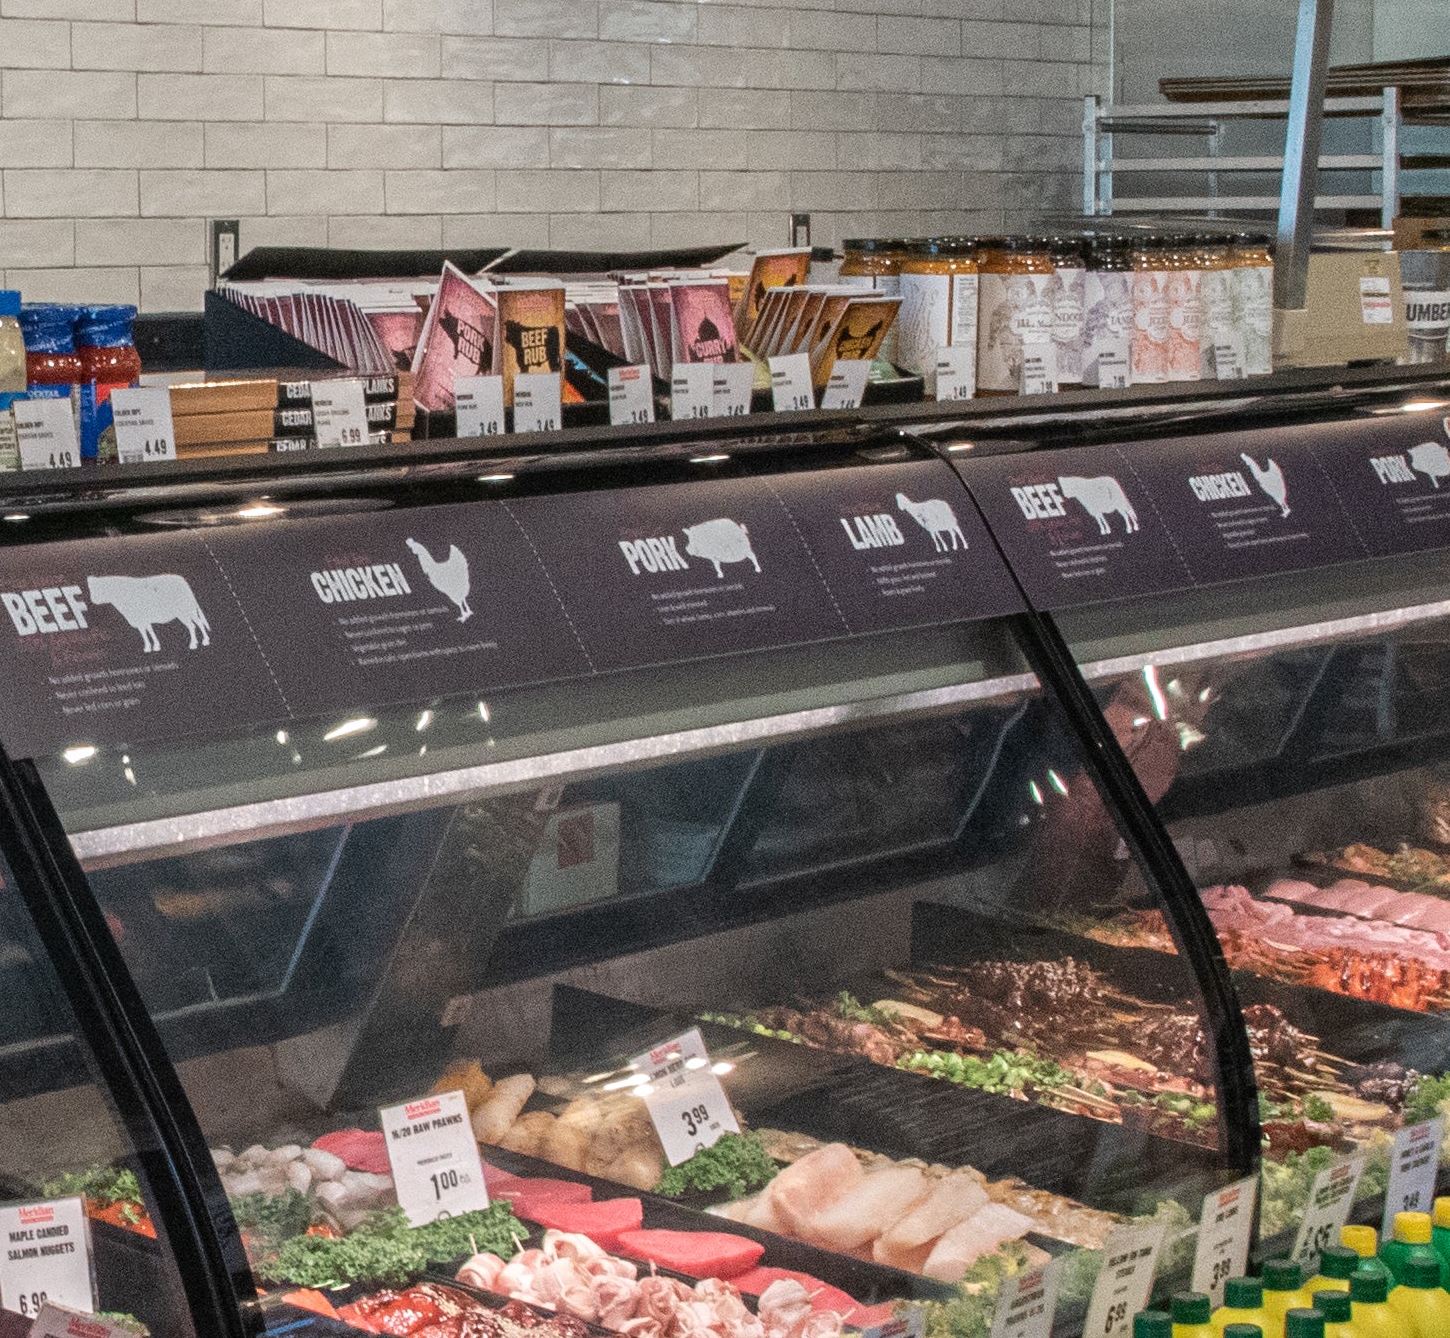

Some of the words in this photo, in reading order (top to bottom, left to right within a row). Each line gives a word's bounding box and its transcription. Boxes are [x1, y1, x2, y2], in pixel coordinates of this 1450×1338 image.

[519, 327, 549, 348] BEEF
[522, 344, 548, 365] RUB
[1010, 481, 1065, 521] BEEF
[841, 514, 905, 551] LAMB
[619, 533, 690, 576] PORK
[309, 561, 412, 605] CHICKEN
[2, 583, 90, 638] BEEF
[8, 1228, 37, 1243] MAPLE
[41, 1241, 77, 1258] NUGGETS
